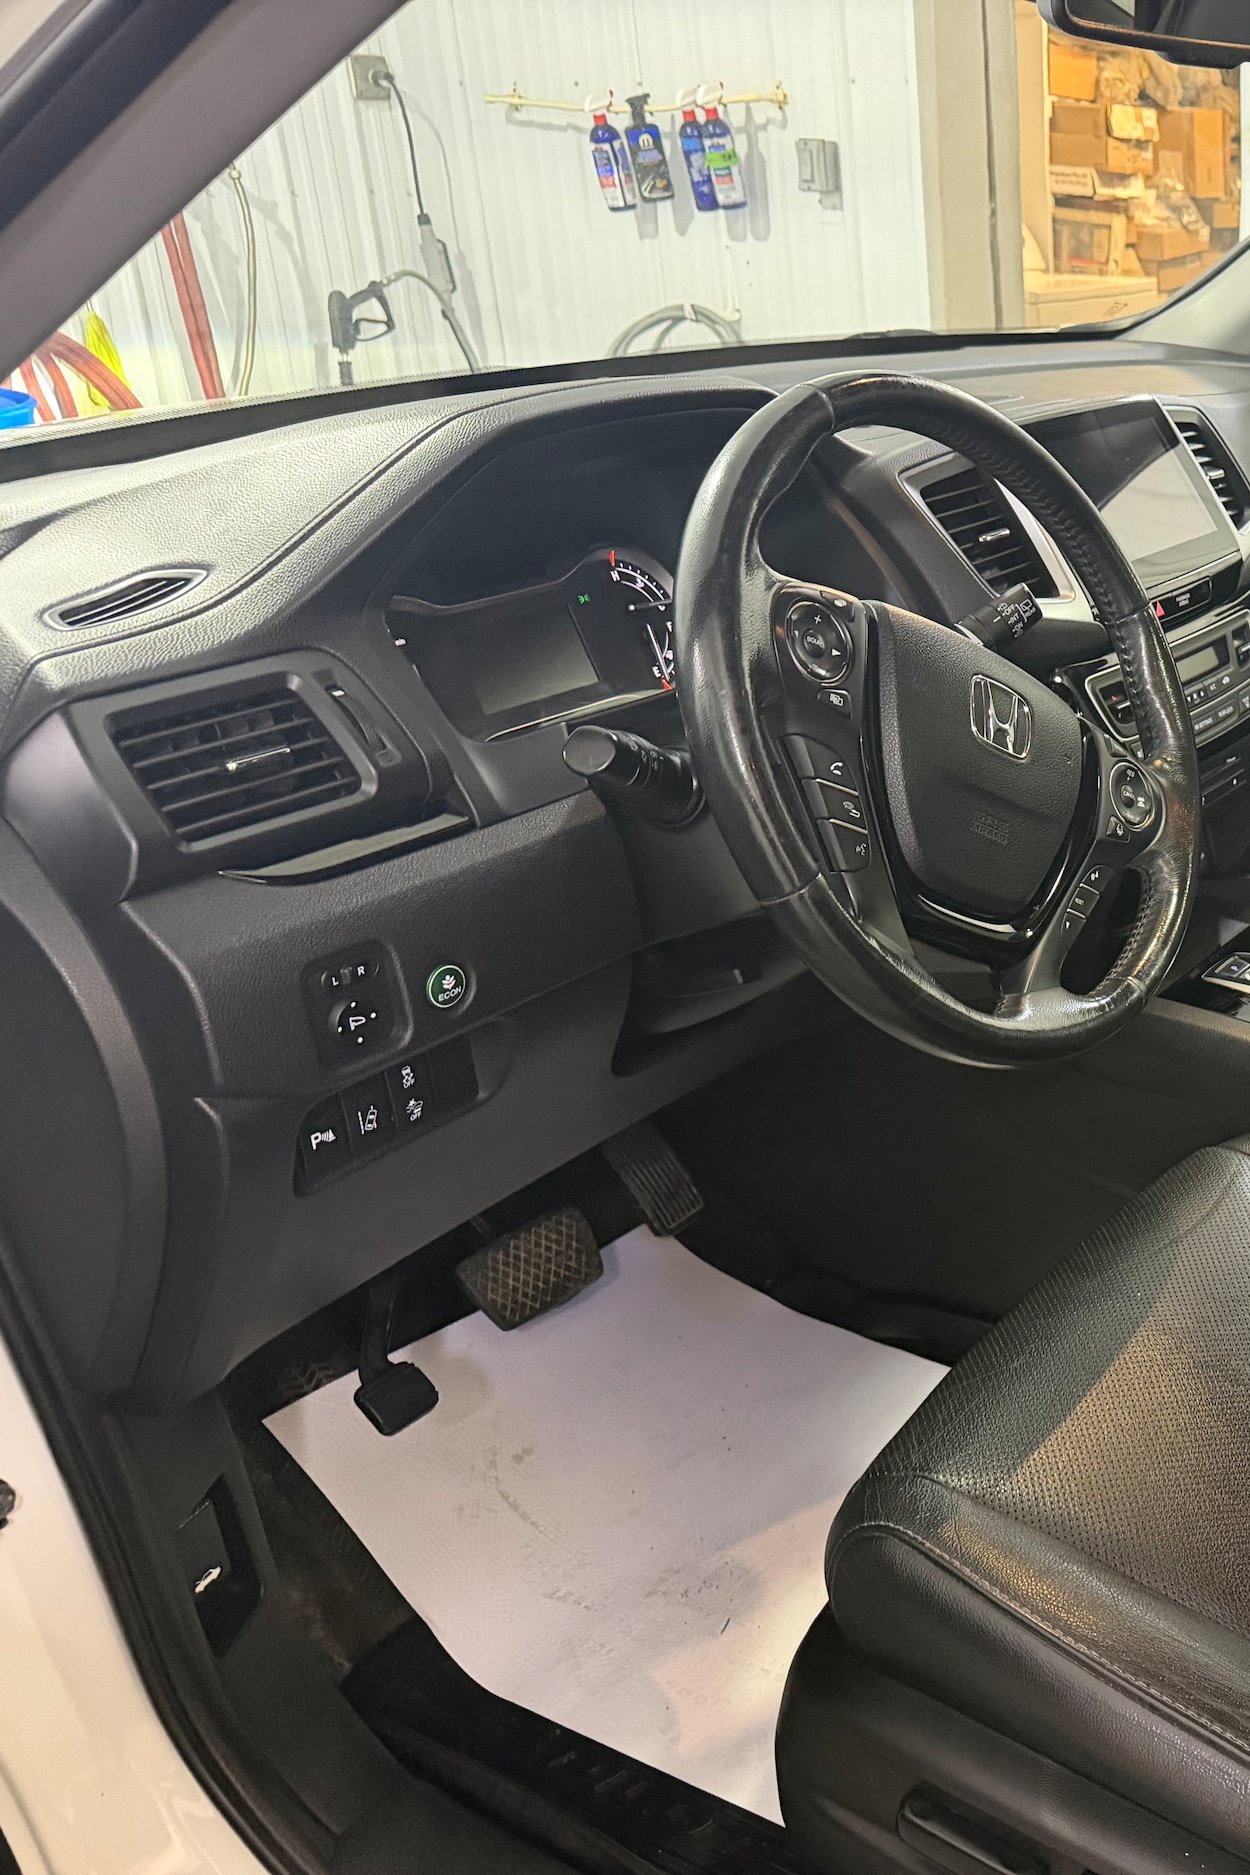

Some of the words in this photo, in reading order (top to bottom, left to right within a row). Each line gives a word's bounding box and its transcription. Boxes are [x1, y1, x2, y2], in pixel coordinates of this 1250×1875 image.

[331, 976, 340, 987] L
[357, 965, 366, 977] R
[438, 985, 462, 1002] ECON
[410, 1111, 422, 1122] OFF
